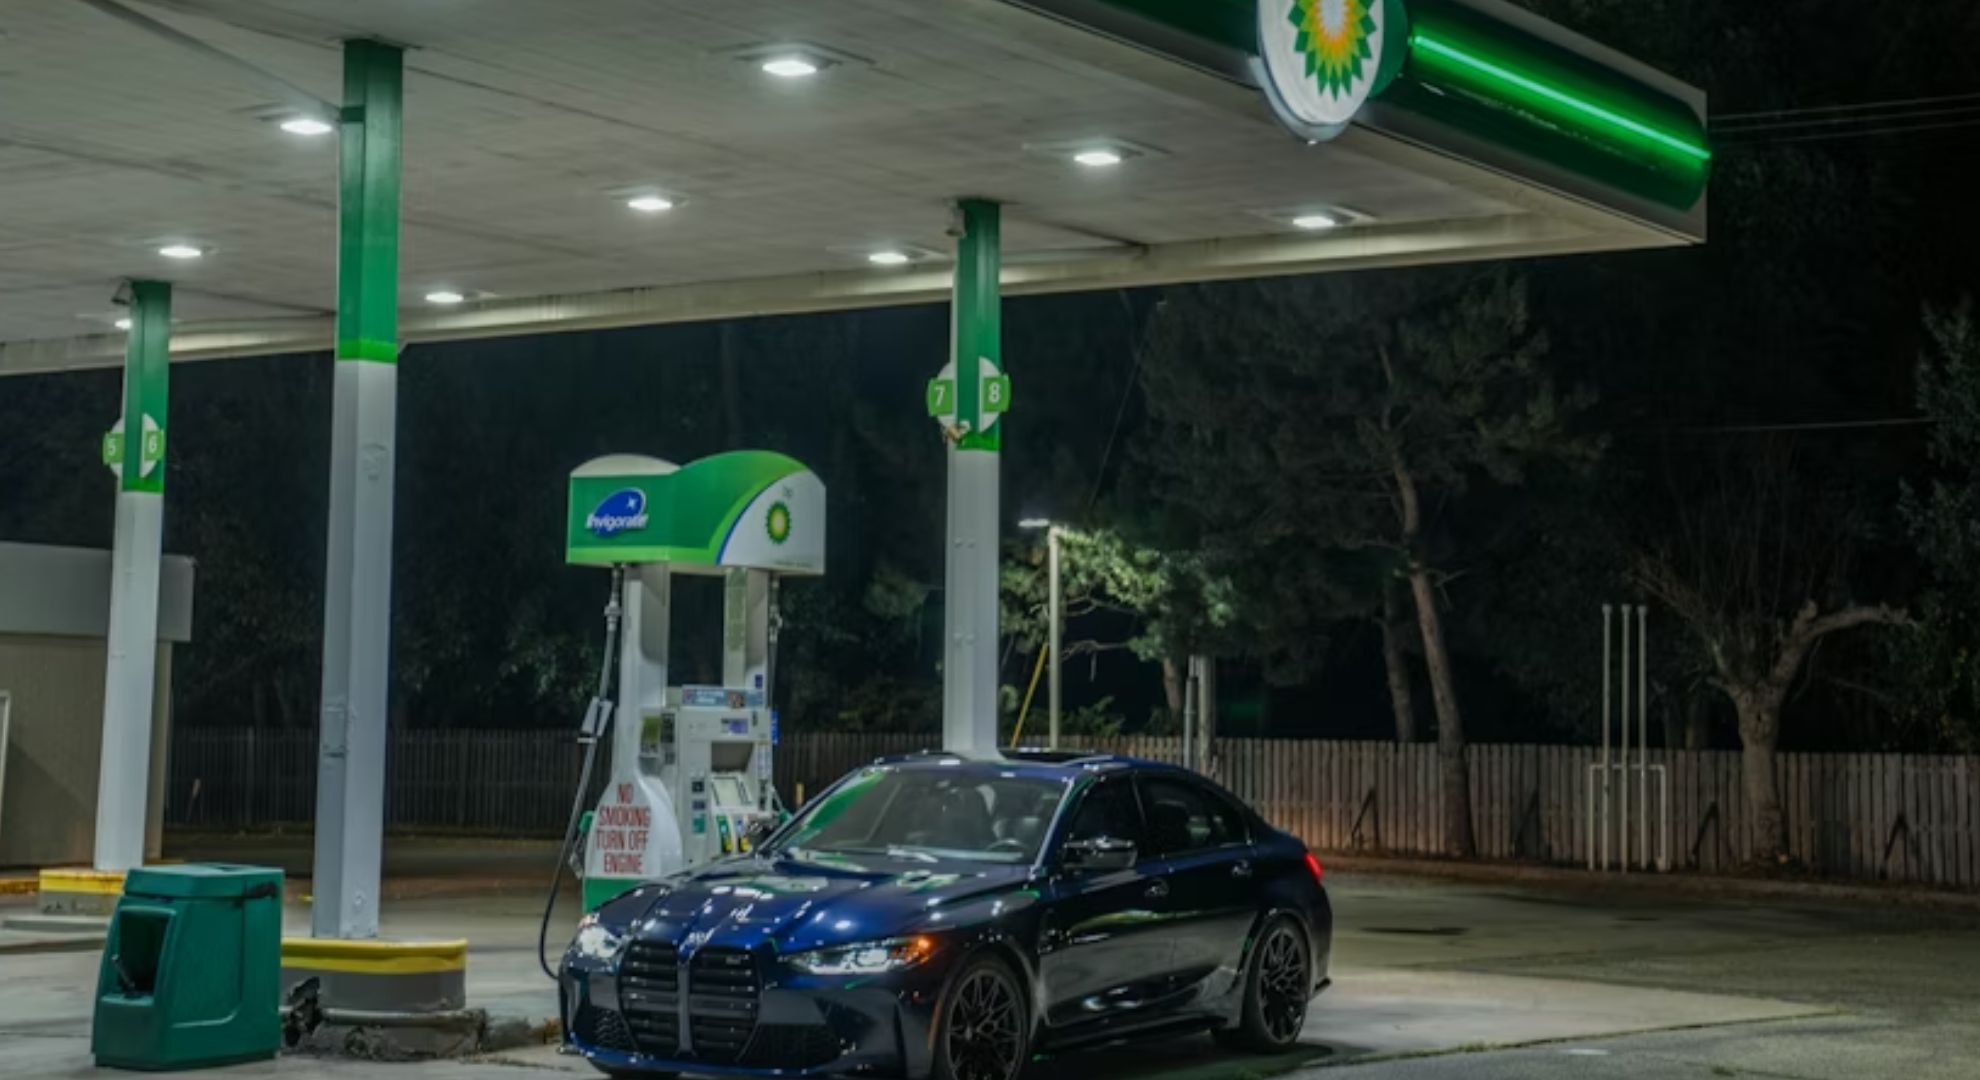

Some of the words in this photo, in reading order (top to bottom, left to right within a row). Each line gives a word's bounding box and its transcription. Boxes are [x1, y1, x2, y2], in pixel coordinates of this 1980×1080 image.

[935, 385, 945, 406] 7
[989, 382, 1000, 403] 8
[107, 438, 116, 456] 5
[148, 435, 157, 454] 6
[618, 783, 634, 804] NO
[599, 806, 652, 826] SMOKING
[596, 830, 625, 850] TURN
[628, 830, 648, 850] OFF
[604, 853, 643, 874] ENGINE
